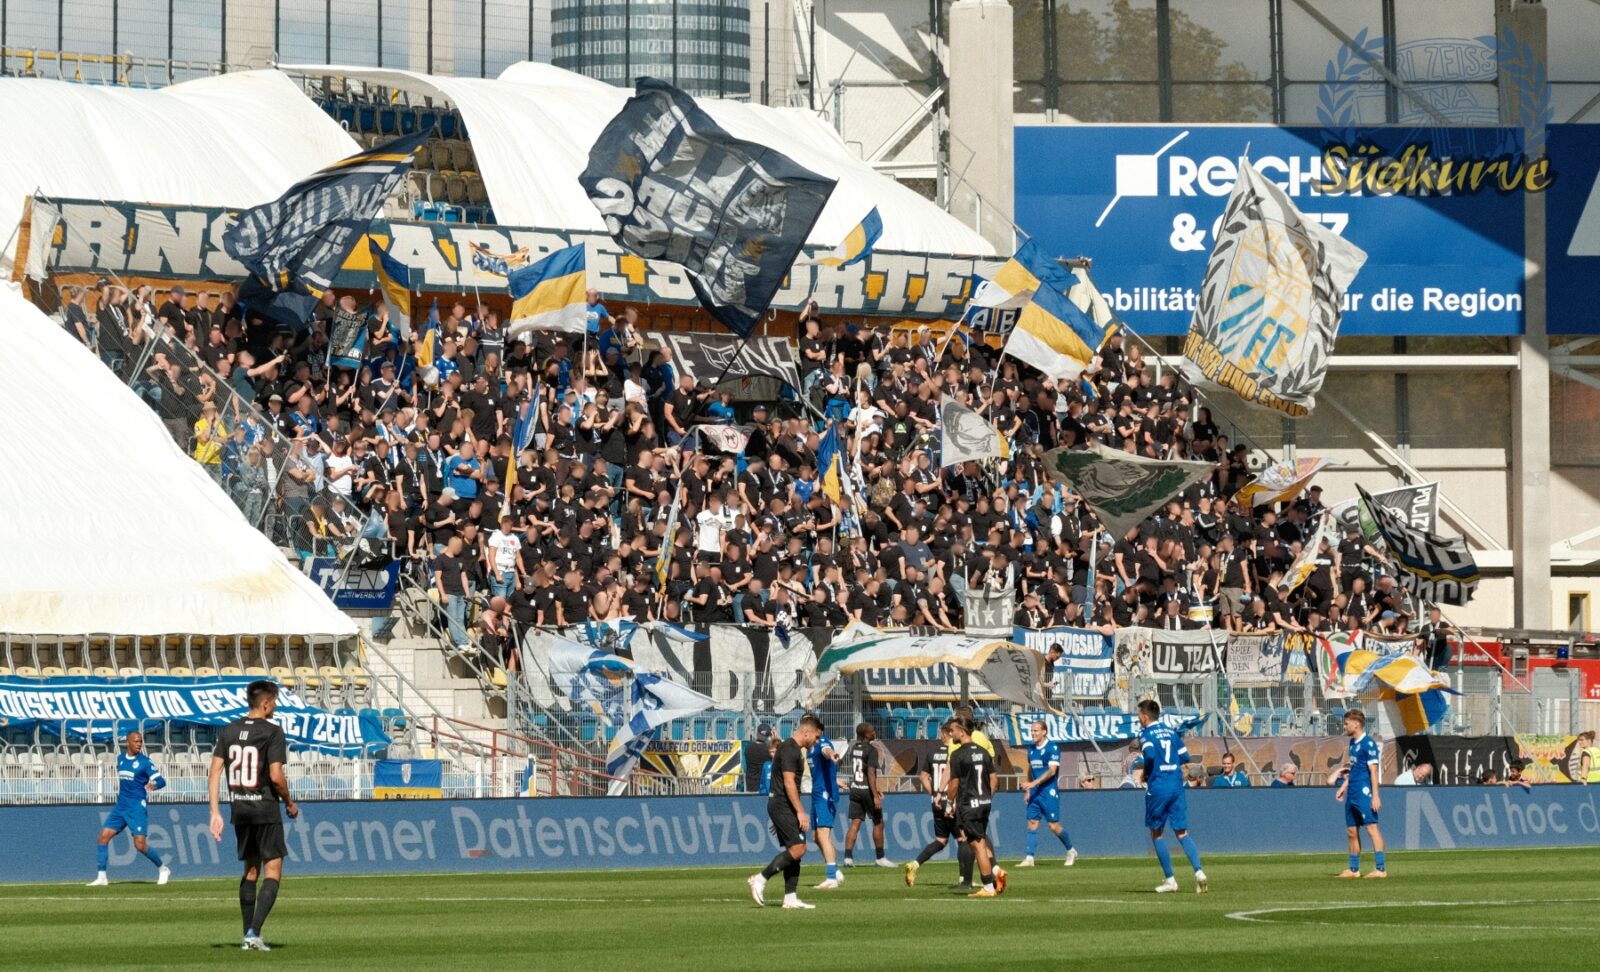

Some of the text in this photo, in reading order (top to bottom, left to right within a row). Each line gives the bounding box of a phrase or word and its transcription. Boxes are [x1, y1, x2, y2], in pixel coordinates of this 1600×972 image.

[1170, 213, 1206, 252] &
[1102, 287, 1199, 311] obilität
[1371, 287, 1413, 310] die
[1424, 287, 1522, 317] Region
[1410, 486, 1435, 534] POLIZ
[0, 689, 137, 720] ONSEQUENT
[138, 689, 194, 719] UND
[228, 744, 259, 788] 20
[1160, 740, 1172, 764] 7
[1452, 794, 1499, 836] ad
[1502, 793, 1569, 835] hoc
[281, 809, 437, 863] xterner
